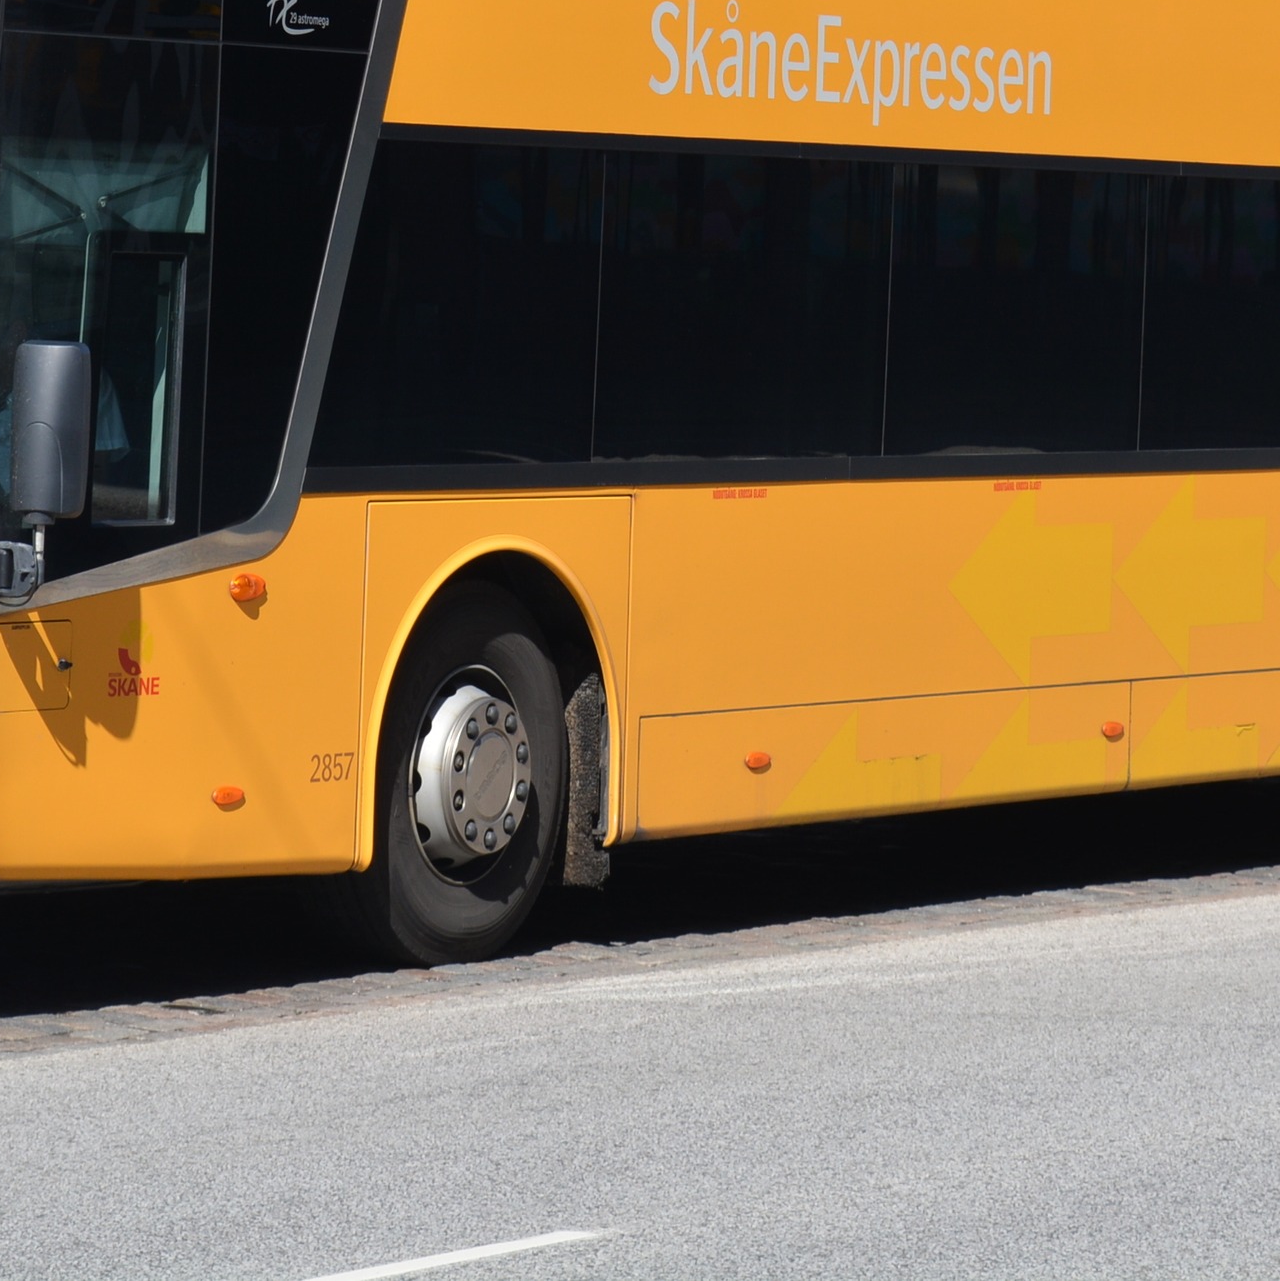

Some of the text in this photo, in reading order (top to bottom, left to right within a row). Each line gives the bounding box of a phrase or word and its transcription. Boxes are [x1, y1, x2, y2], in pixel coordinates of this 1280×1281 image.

[298, 13, 330, 29] astromega
[649, 0, 1053, 126] SkåneExpressen
[309, 752, 355, 783] 2857
